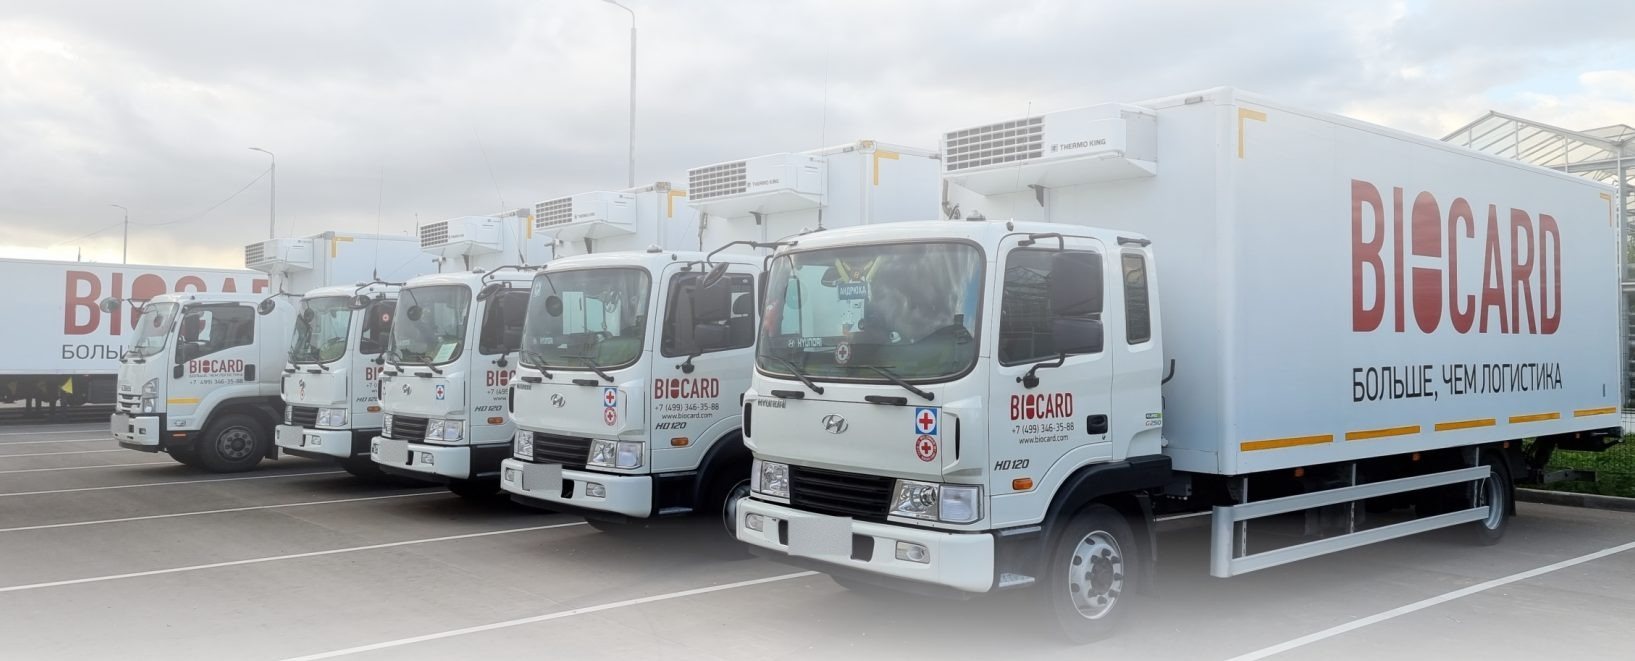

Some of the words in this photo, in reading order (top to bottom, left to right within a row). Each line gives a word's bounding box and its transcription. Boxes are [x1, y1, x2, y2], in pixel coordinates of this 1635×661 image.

[1060, 141, 1088, 151] THERMO
[1090, 138, 1106, 146] KING
[1351, 178, 1562, 335] BIOCARD
[189, 360, 244, 373] BIOCARD
[1353, 365, 1438, 402] БОЛЬШЕ,
[1442, 363, 1477, 395] ЧЕМ
[1481, 362, 1562, 393] ЛОГИСТИКА
[655, 378, 719, 400] BIOCARD
[665, 403, 683, 412] (499)
[684, 402, 720, 411] 346-35-88
[1010, 393, 1073, 421] BIOCARD
[1012, 426, 1020, 434] +7
[1022, 424, 1039, 434] (499)
[1041, 422, 1075, 433] 346-35-88
[1019, 435, 1069, 444] www.biocard.com
